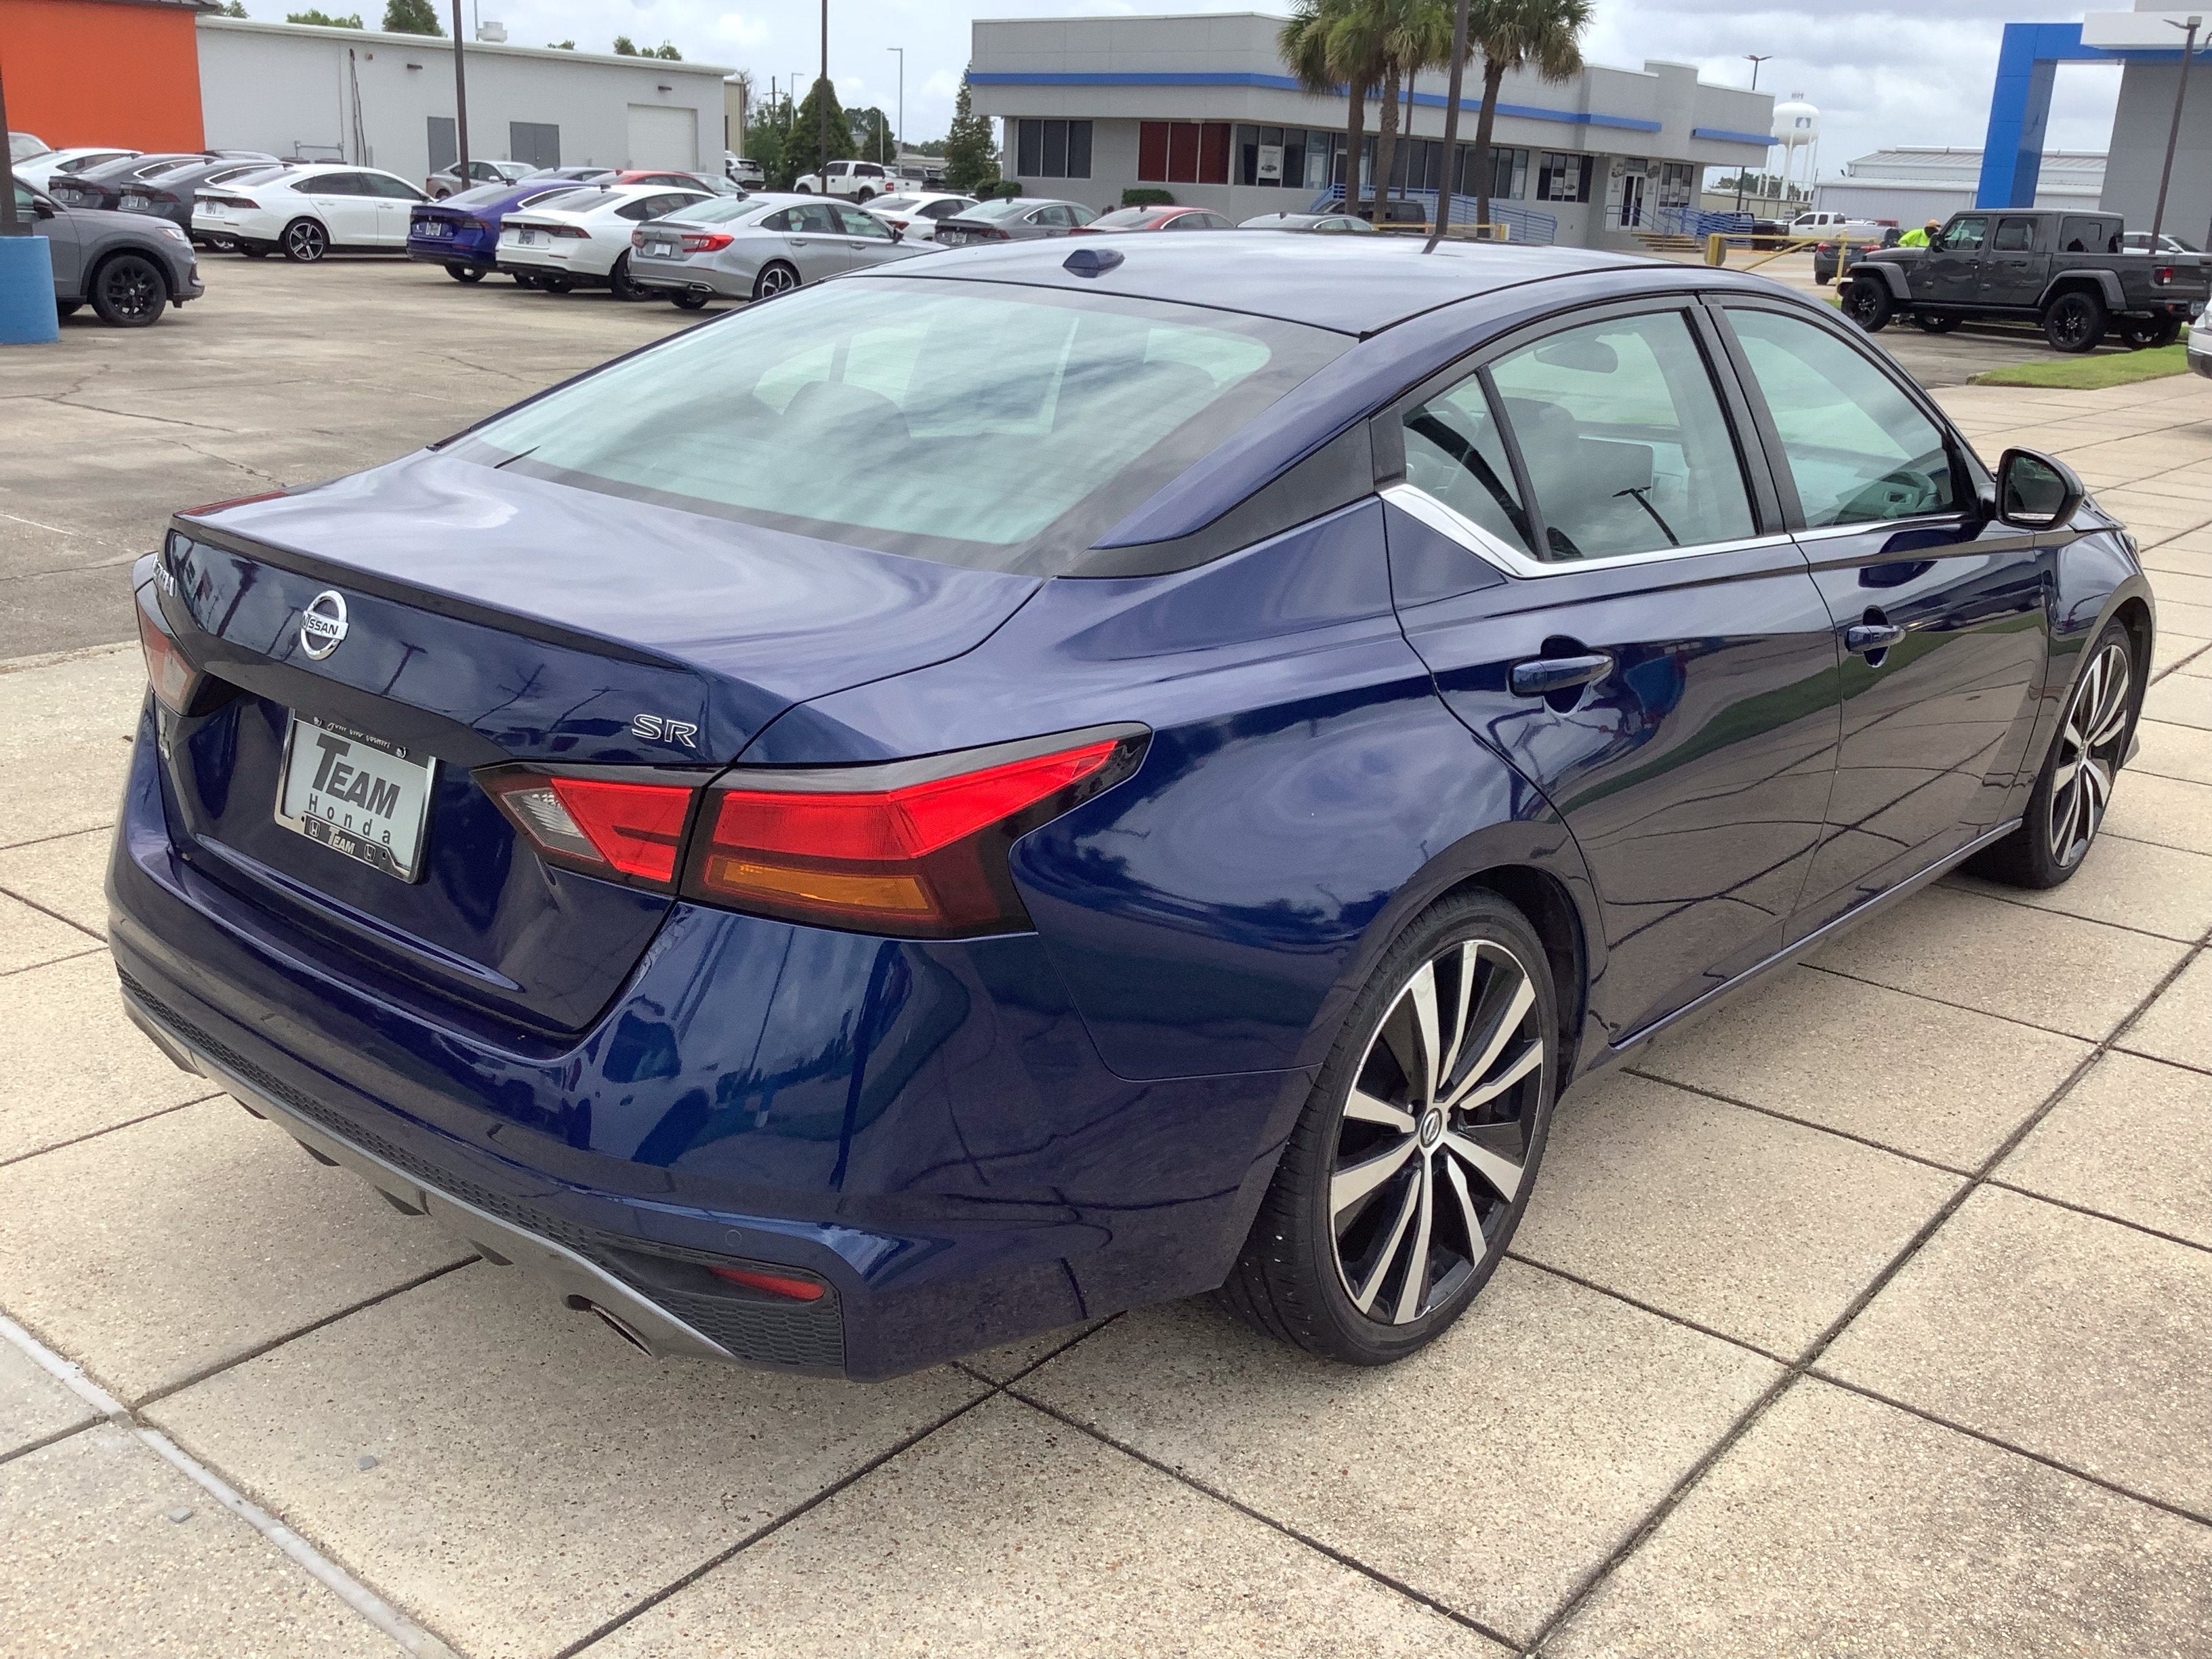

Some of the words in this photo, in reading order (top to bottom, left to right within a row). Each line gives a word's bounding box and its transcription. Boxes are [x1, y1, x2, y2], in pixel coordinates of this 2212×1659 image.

[302, 613, 338, 635] NISSAN
[632, 714, 697, 748] SR
[312, 733, 401, 819] TEAM
[309, 794, 390, 844] Honda
[327, 826, 355, 854] TEAM
